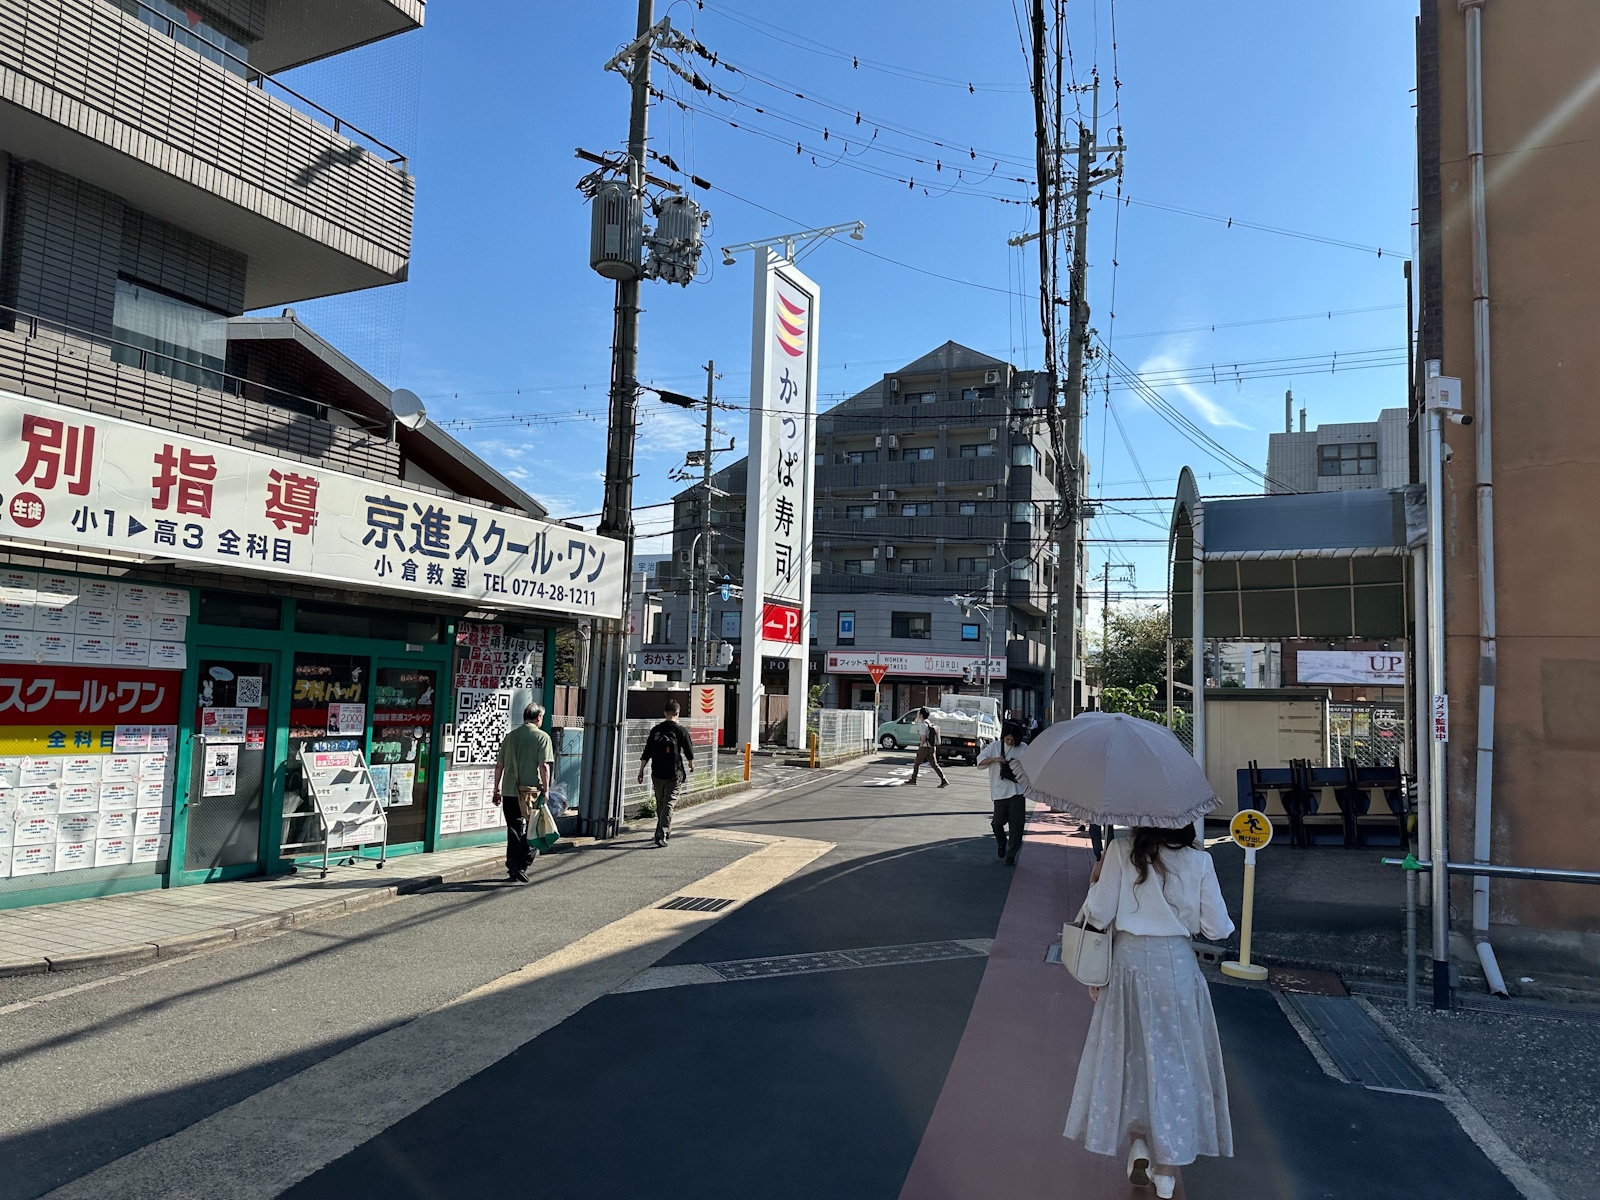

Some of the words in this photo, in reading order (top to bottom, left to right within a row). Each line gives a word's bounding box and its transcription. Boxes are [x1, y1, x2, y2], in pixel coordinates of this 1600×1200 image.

[774, 367, 798, 584] かっぱ寿司
[12, 498, 43, 520] 生徒
[217, 529, 291, 564] 全科目
[362, 494, 606, 583] 京進スクール・ワン
[373, 554, 468, 590] 小倉教室
[484, 572, 507, 594] TEL
[512, 578, 596, 607] 0774-28-1211
[784, 611, 798, 639] P
[770, 661, 817, 671] POH
[0, 678, 165, 713] スクール・ワン
[1435, 696, 1446, 740] カメラ監視中
[47, 729, 113, 748] 全科目
